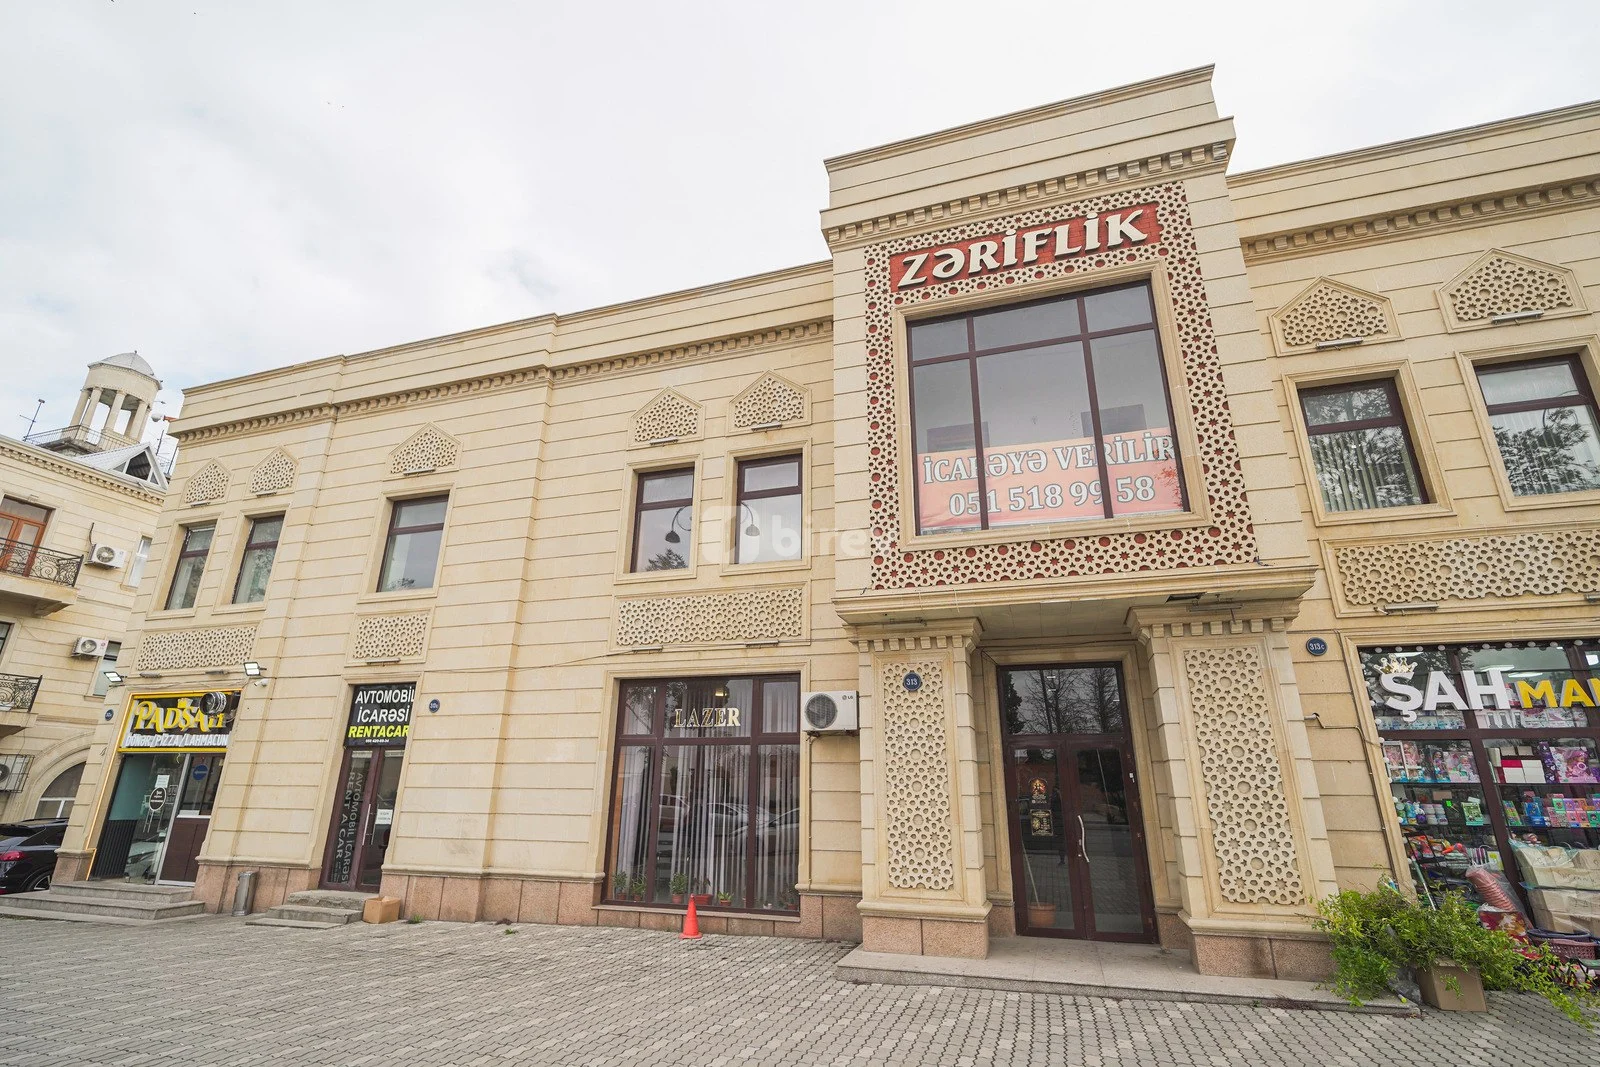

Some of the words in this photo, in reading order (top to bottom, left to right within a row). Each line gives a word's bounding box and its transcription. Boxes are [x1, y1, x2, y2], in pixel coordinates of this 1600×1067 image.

[897, 209, 1148, 287] ZƏRİFLİK
[1053, 432, 1175, 470] VERİLİR
[950, 489, 1000, 516] 051
[1009, 484, 1063, 511] 518
[1069, 480, 1104, 506] 99
[1116, 476, 1155, 502] 58
[906, 678, 918, 686] 313
[355, 686, 415, 704] AVTOMOBİL
[1379, 668, 1511, 722] ŞAH
[1516, 677, 1600, 709] MA
[357, 704, 410, 723] İCARƏSİ
[673, 708, 741, 728] LAZER
[348, 724, 410, 738] RENTACAR
[343, 772, 356, 810] RENT
[341, 813, 348, 824] A
[335, 828, 346, 859] CAR
